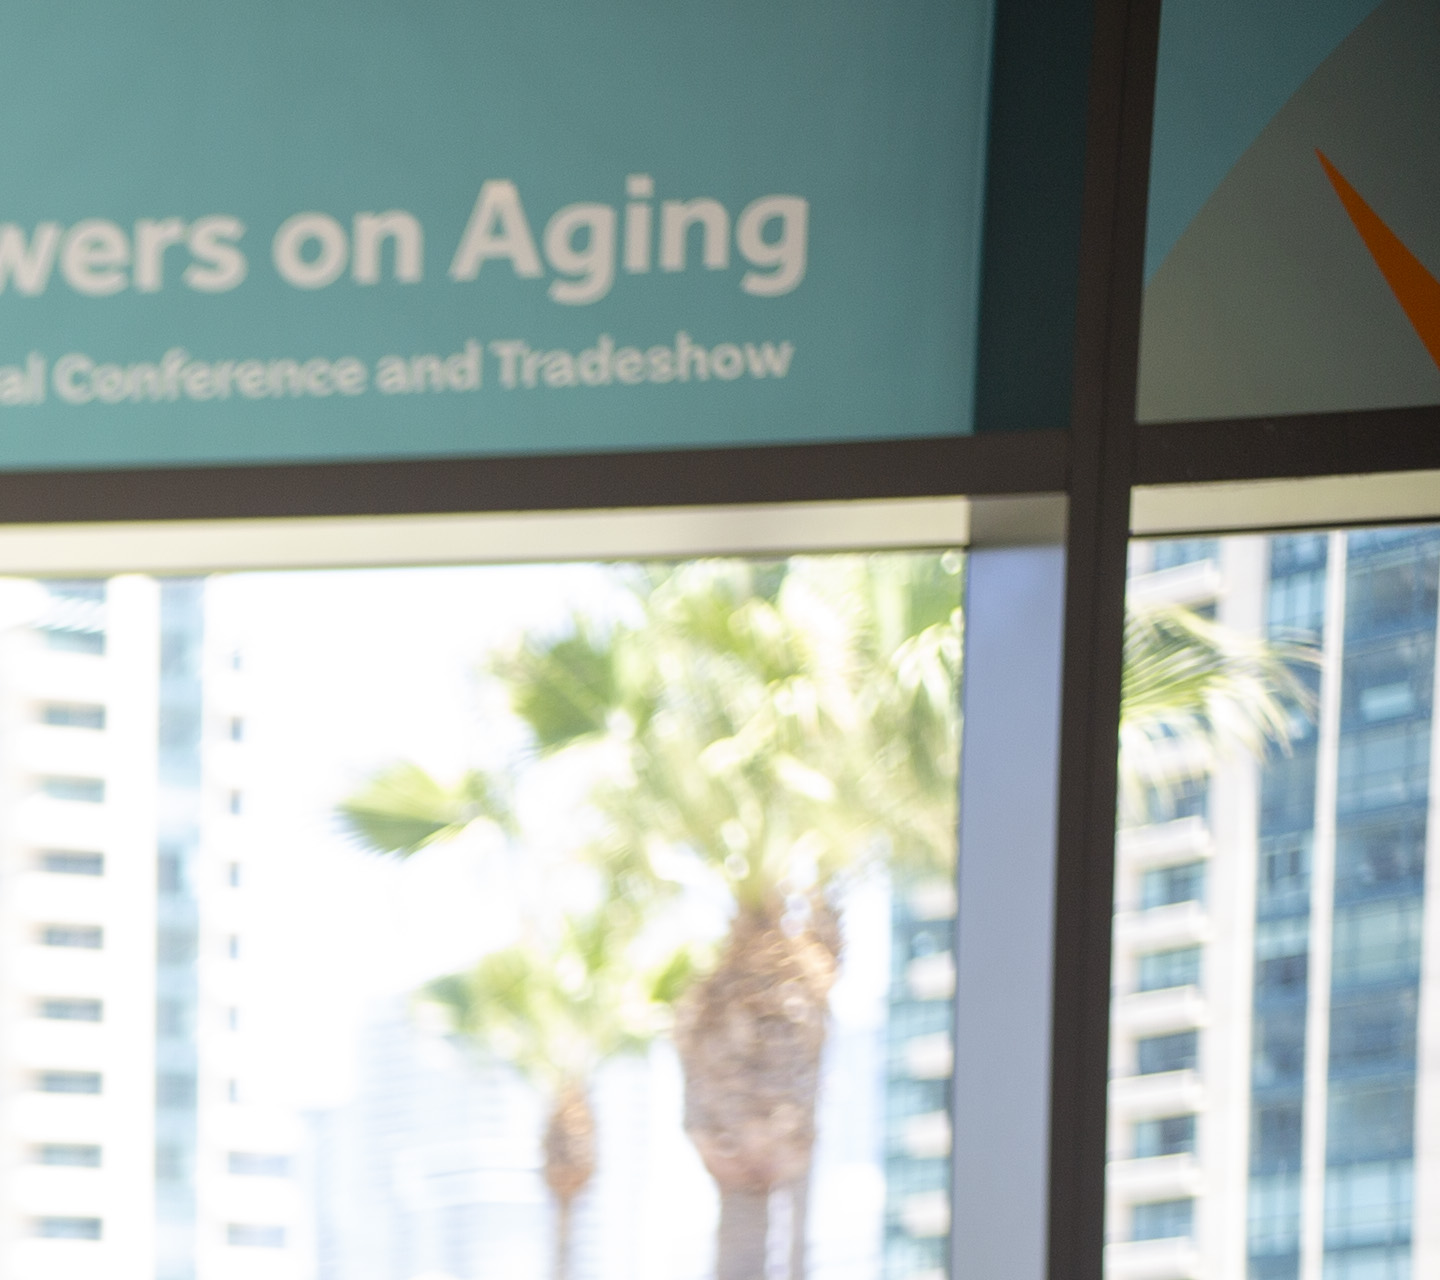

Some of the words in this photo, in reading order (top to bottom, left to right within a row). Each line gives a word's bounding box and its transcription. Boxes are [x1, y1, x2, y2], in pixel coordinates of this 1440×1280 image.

[273, 207, 424, 290] on
[449, 173, 811, 306] Aging
[55, 344, 368, 406] Conference
[377, 340, 481, 395] and
[491, 332, 795, 390] Tradeshow
